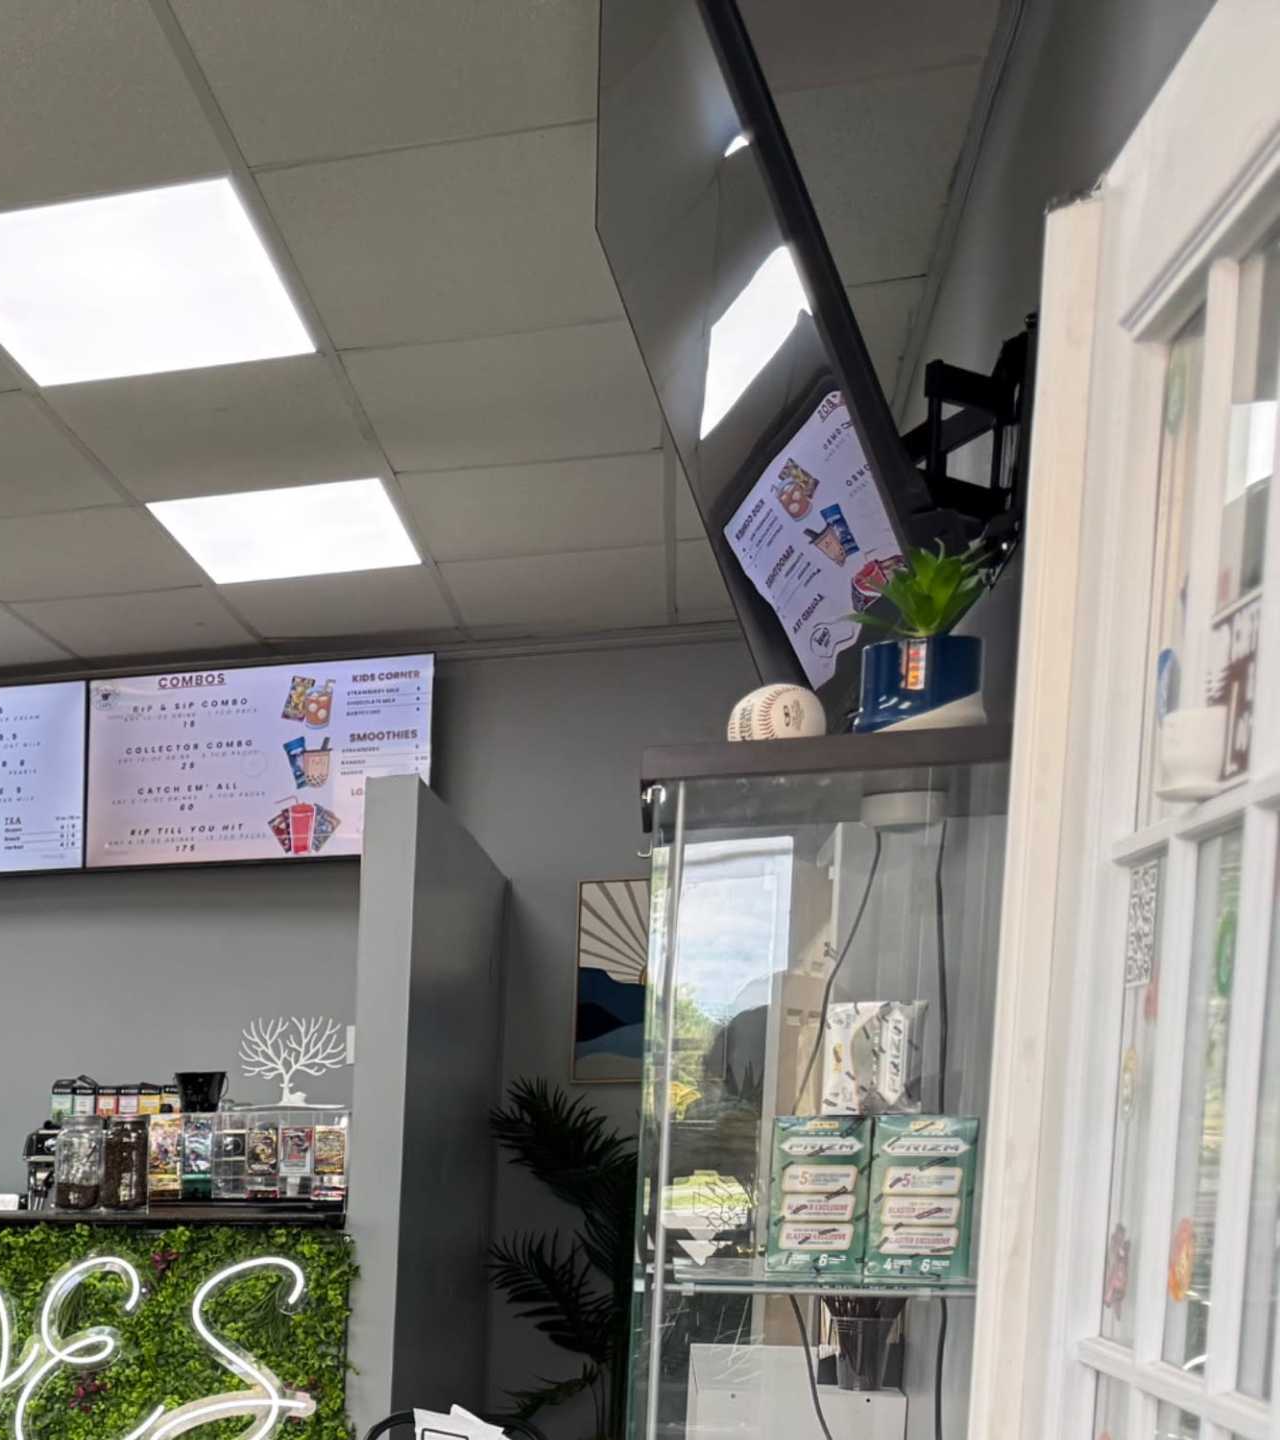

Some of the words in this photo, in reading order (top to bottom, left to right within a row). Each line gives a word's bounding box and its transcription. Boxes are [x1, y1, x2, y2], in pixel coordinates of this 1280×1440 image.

[158, 673, 226, 690] COMBOS
[352, 673, 376, 683] KIDS
[377, 670, 421, 681] CORNER
[201, 697, 248, 708] COMBO
[350, 729, 419, 743] SMOOTHIES
[125, 743, 199, 755] COLLECTOR
[206, 739, 254, 750] COMBO
[137, 785, 180, 796] CATCH
[216, 783, 238, 791] ALL
[4, 816, 22, 826] TEA
[191, 825, 216, 833] YOU
[222, 823, 244, 831] HIT
[799, 1171, 809, 1186] 5
[901, 1173, 913, 1188] 5
[920, 1258, 931, 1273] 6
